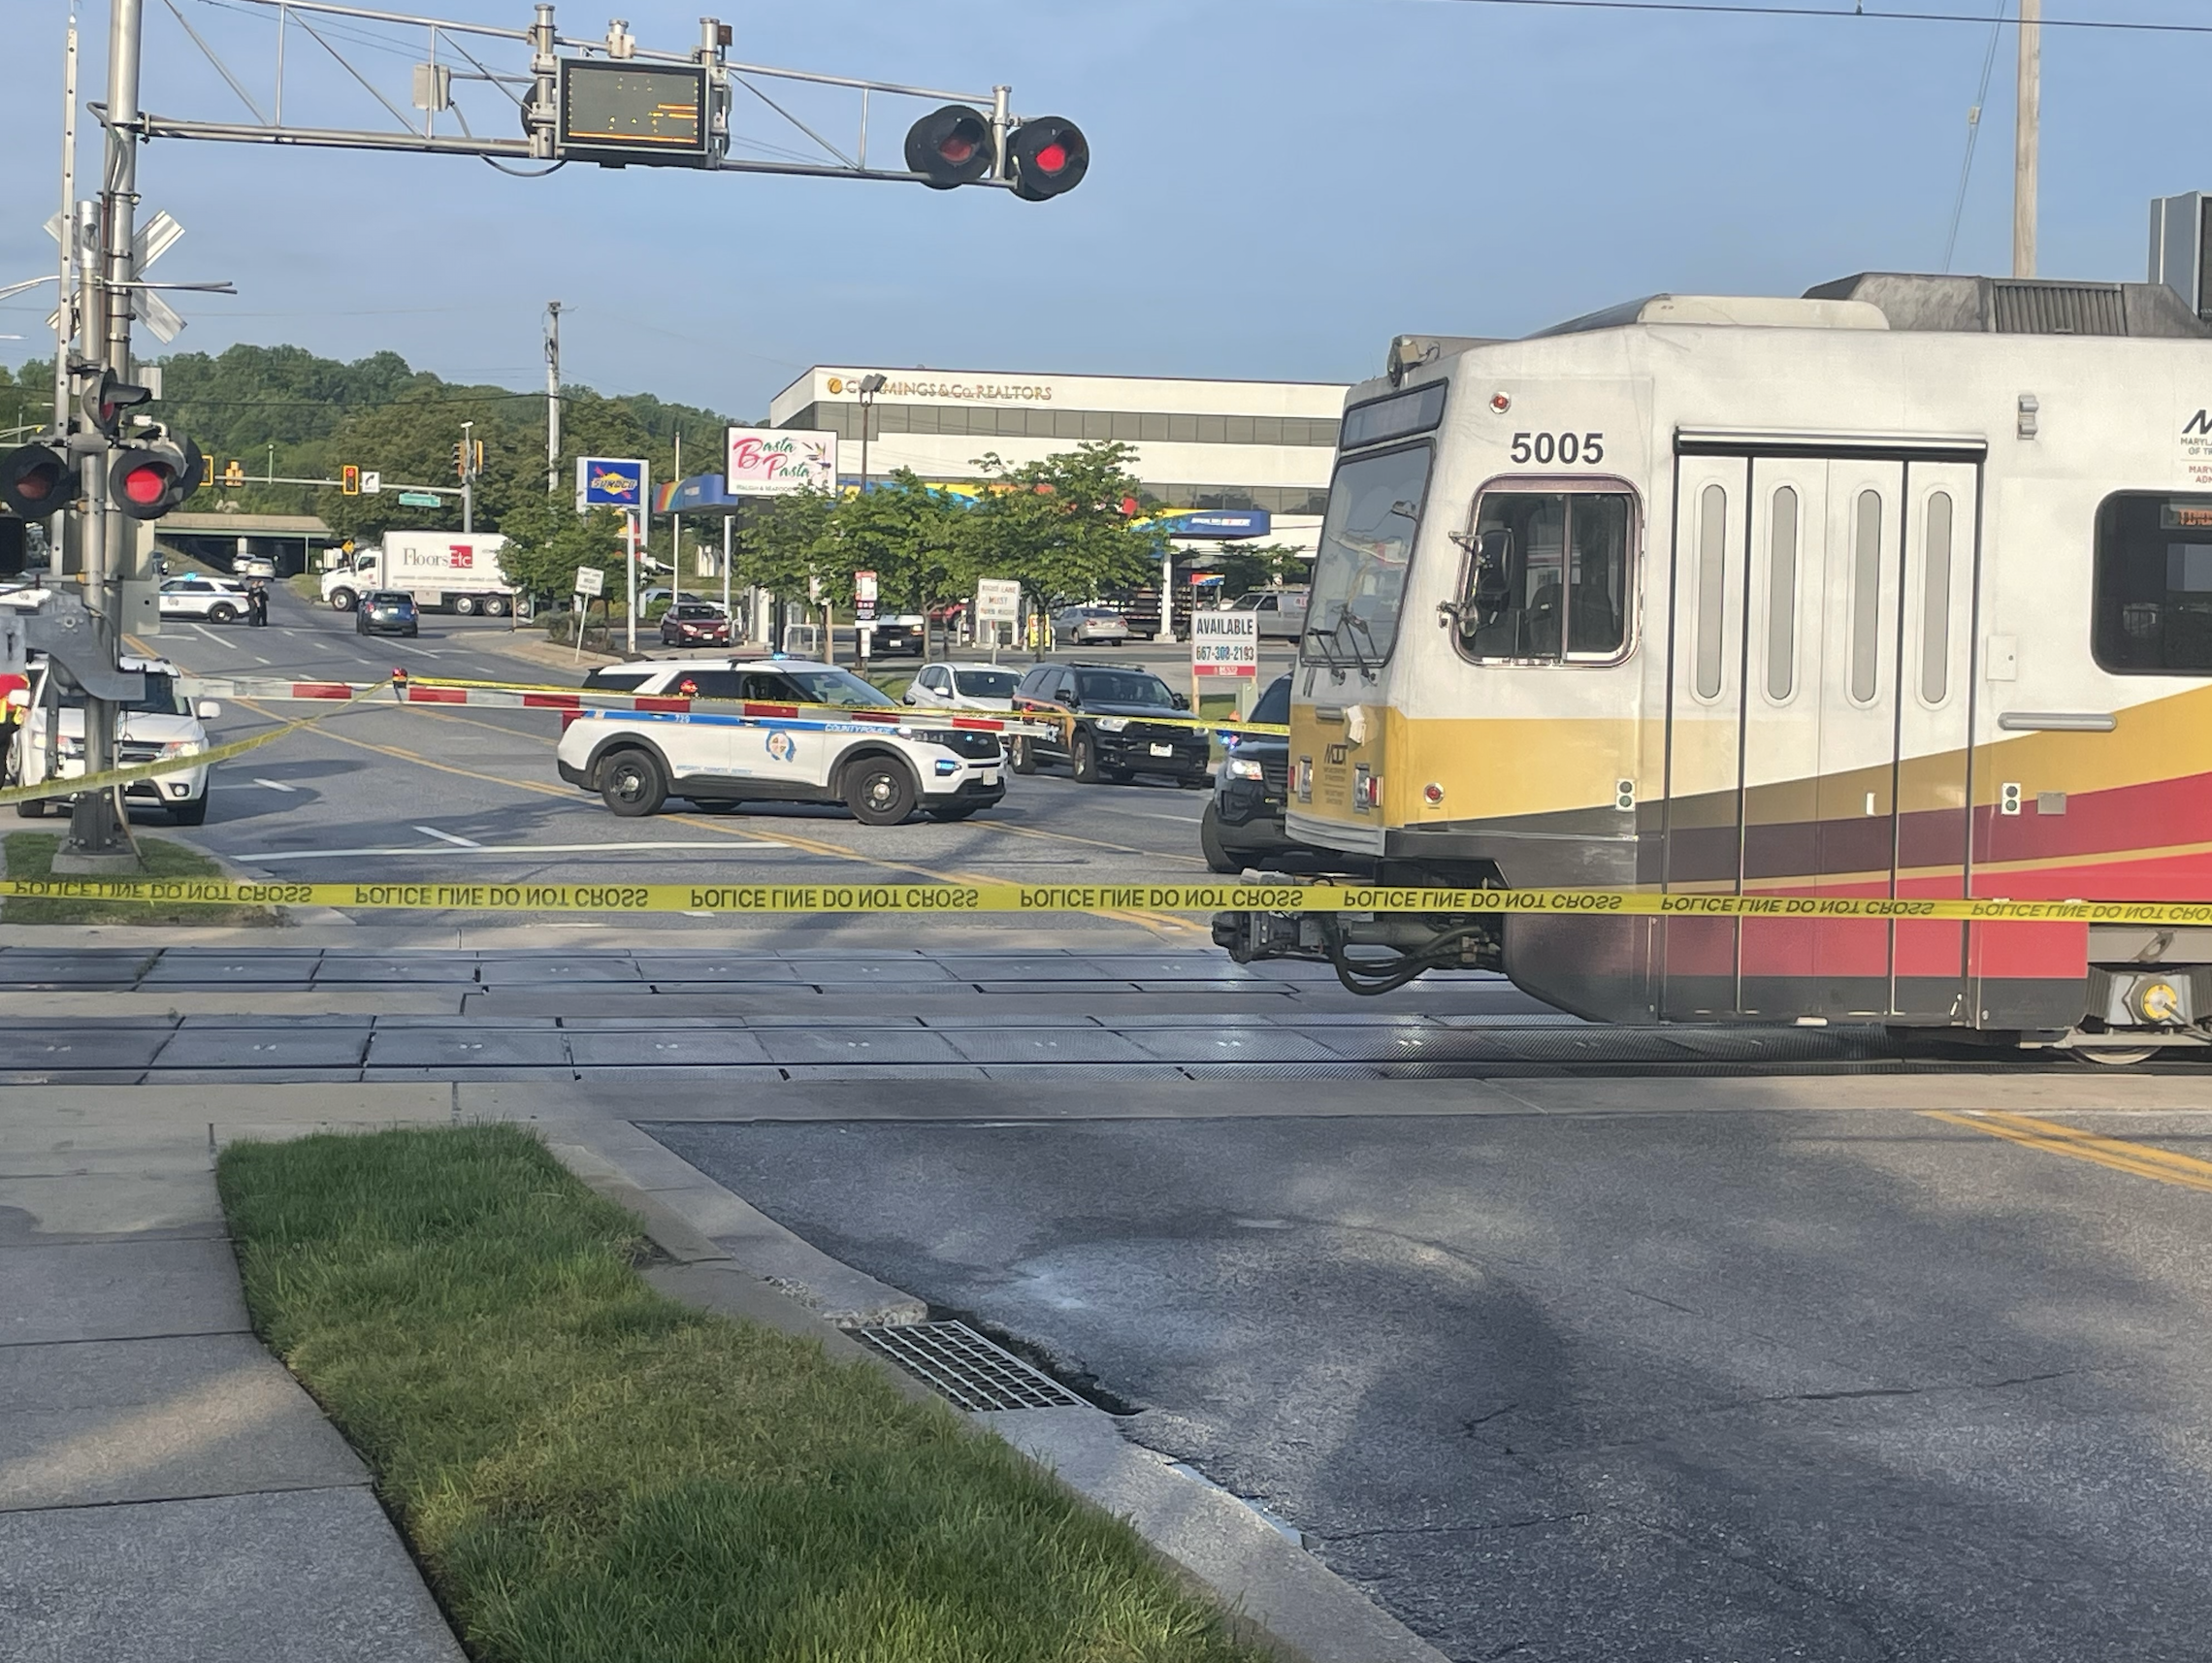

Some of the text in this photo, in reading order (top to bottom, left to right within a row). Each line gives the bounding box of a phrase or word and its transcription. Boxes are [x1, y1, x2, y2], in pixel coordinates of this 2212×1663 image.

[976, 385, 1052, 400] REALTORS
[732, 437, 797, 470] Basta
[1510, 432, 1604, 464] 5005
[763, 453, 810, 480] Pasta
[591, 476, 637, 490] SUNOCO
[403, 547, 472, 567] Floors Etc
[1196, 618, 1253, 635] AVAILABLE
[825, 723, 861, 734] COUNTY
